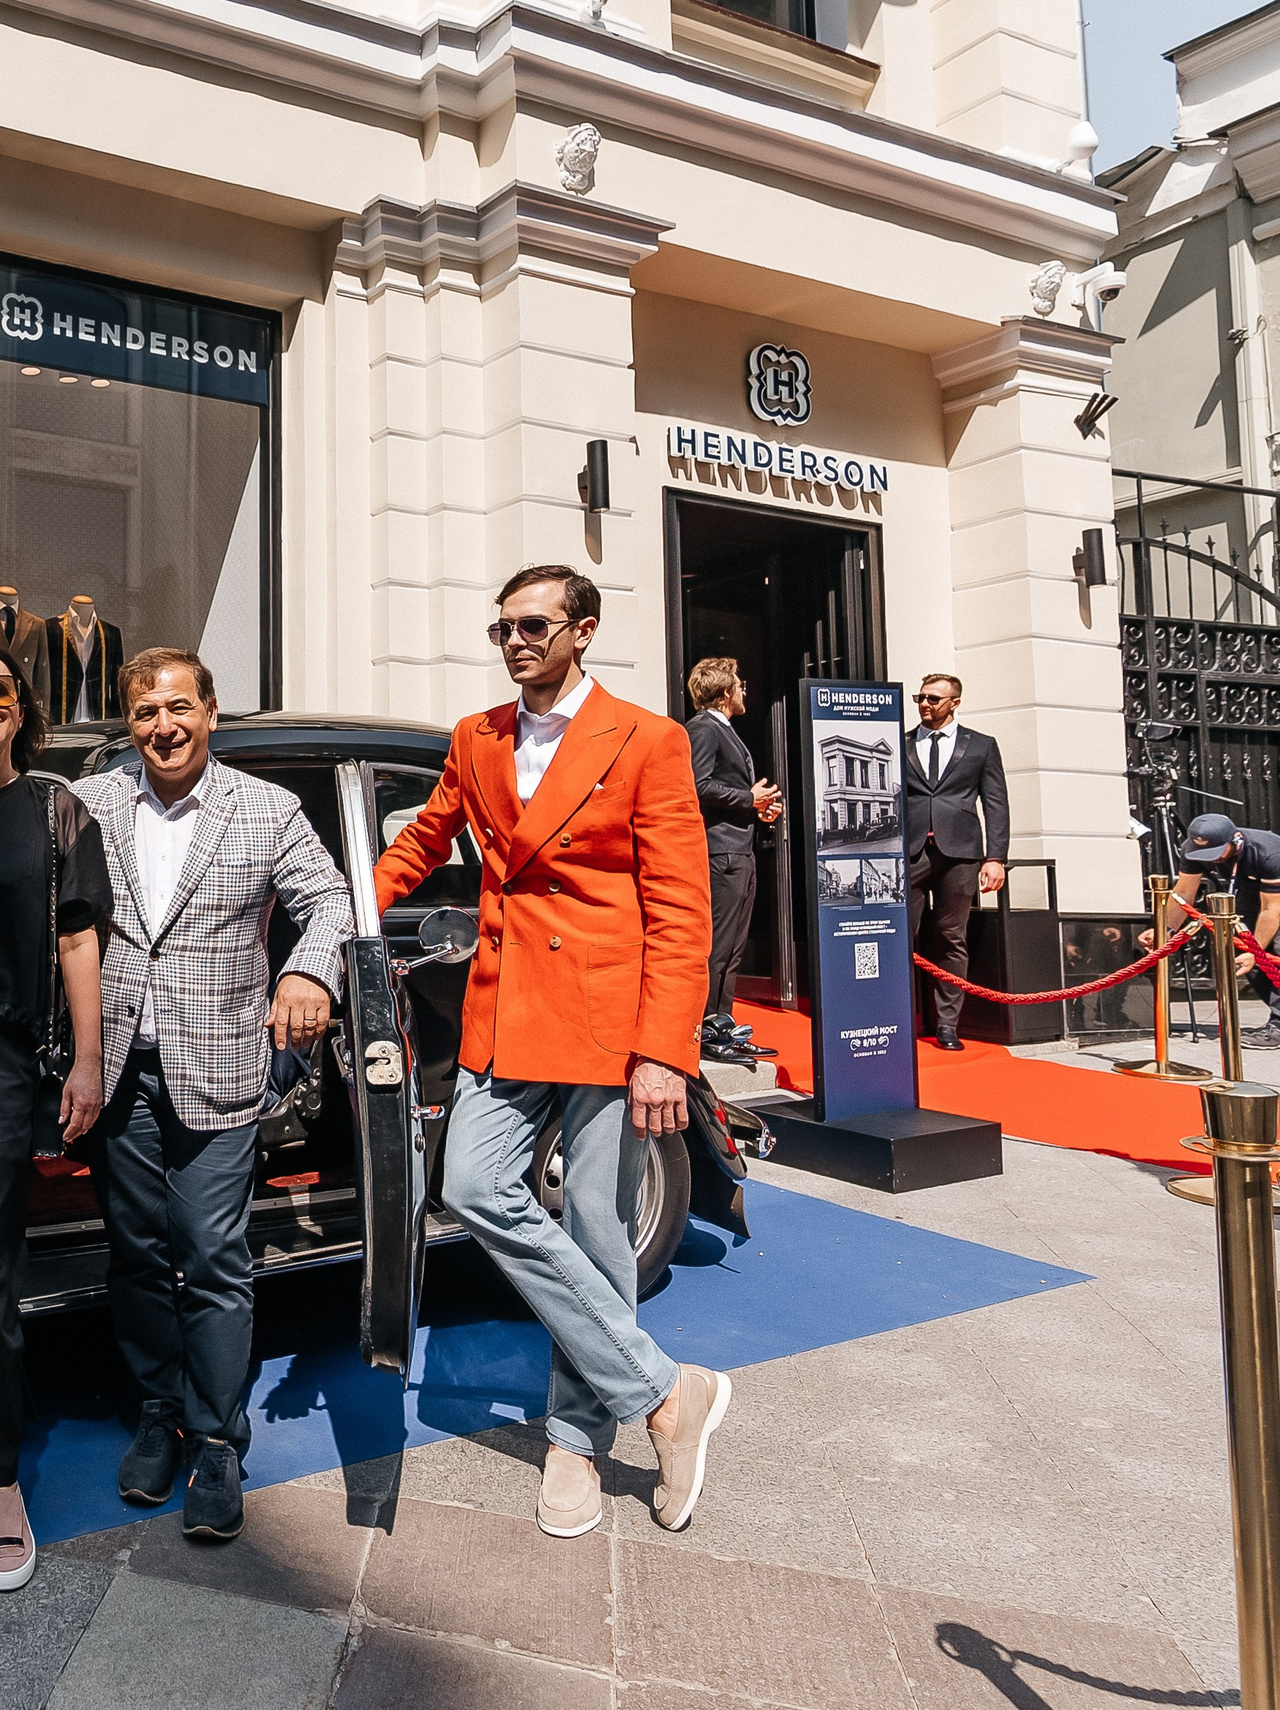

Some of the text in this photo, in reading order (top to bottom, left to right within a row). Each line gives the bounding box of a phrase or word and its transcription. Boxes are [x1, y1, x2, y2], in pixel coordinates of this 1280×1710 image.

[13, 306, 258, 374] H HENDERSON
[671, 425, 889, 494] HENDERSON
[831, 692, 893, 705] HENDERSON
[840, 1025, 898, 1039] КУЗНЕЦКИЙ МОСТ
